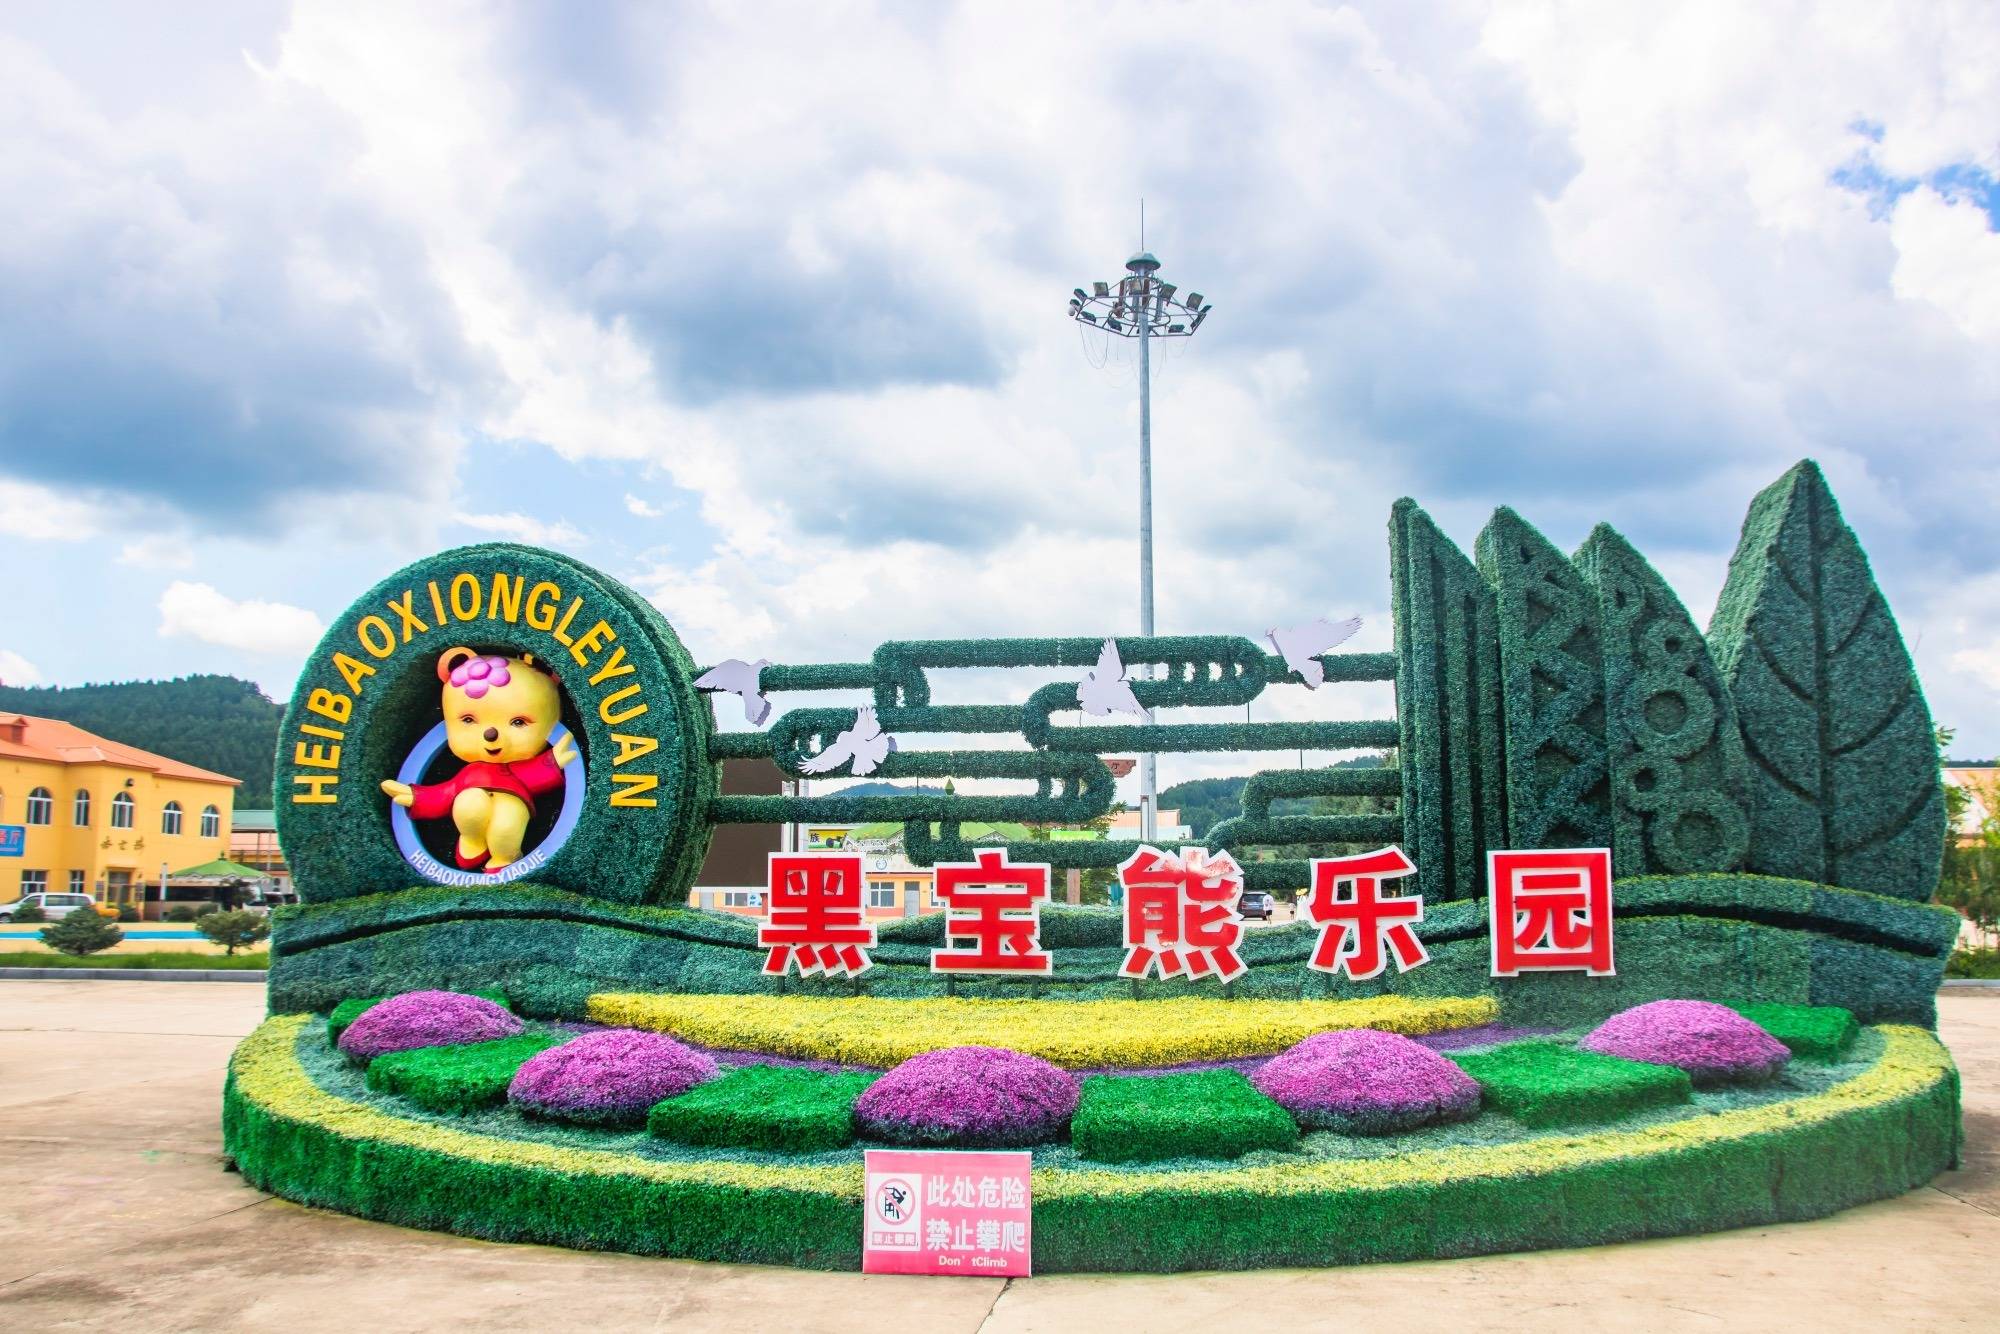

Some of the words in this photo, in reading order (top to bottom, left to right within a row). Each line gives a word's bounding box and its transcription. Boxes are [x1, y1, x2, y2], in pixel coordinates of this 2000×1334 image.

[292, 572, 660, 808] HEIBAOXIONGLEYUAN
[758, 845, 1616, 983] 黑宝熊乐园
[927, 1175, 1026, 1209] 此处危险
[926, 1218, 1026, 1253] 禁止攀爬
[971, 1256, 1008, 1268] tClimb
